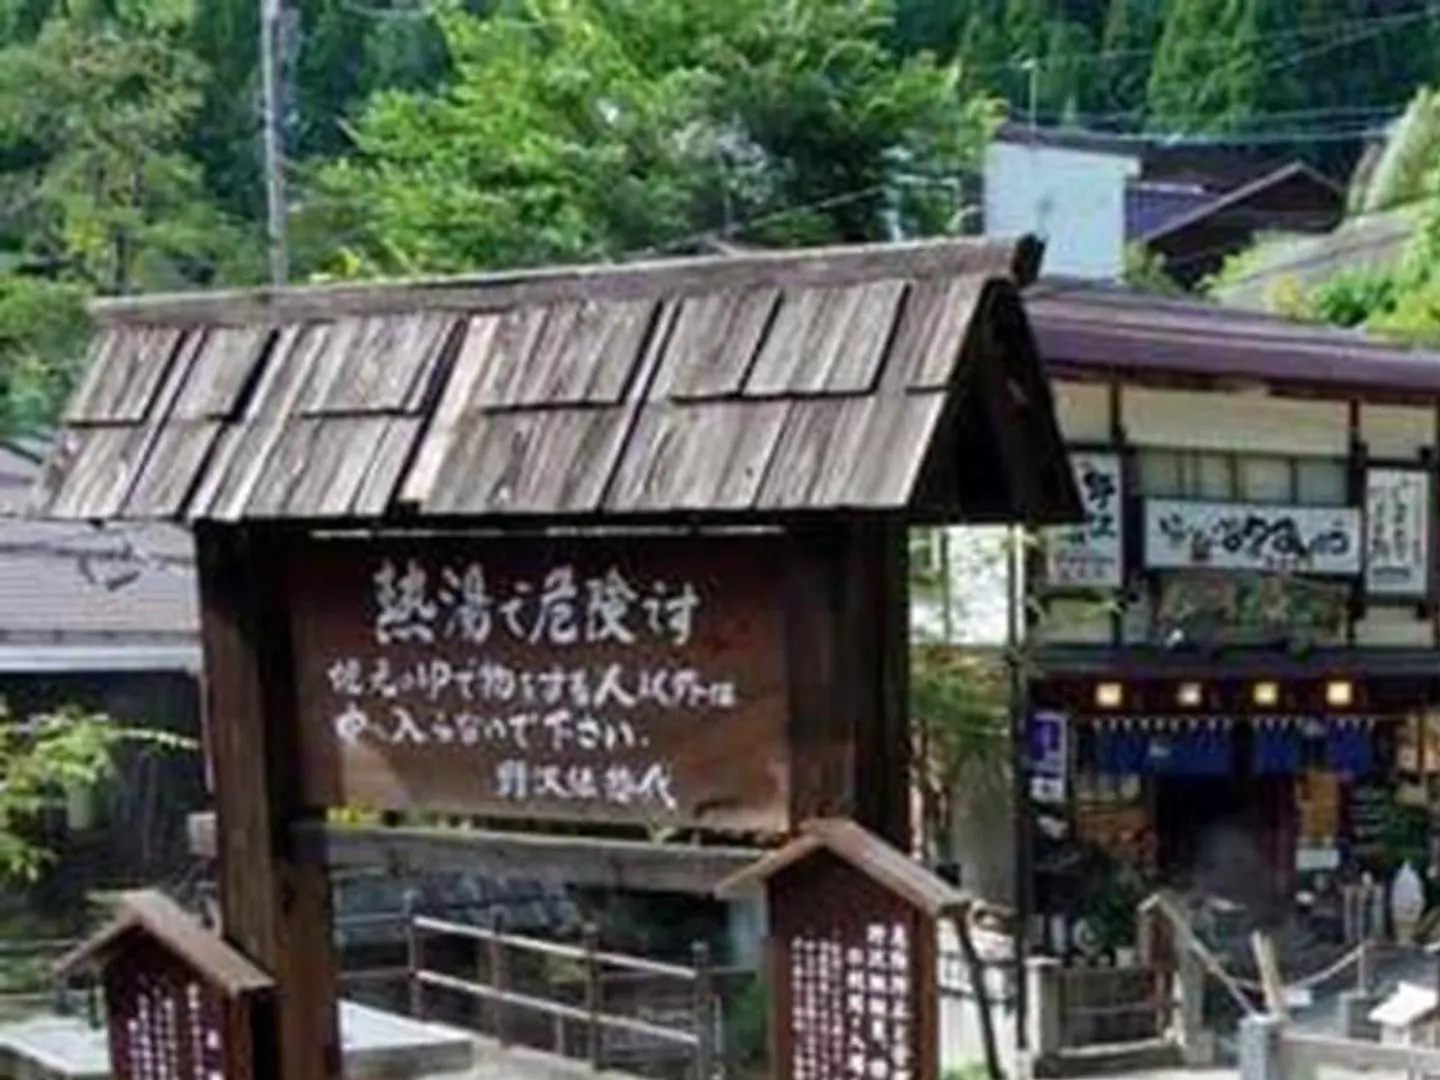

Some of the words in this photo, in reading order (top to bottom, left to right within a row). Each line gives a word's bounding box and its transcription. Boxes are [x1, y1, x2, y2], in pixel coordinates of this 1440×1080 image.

[373, 559, 699, 645] 熱湯で危険です
